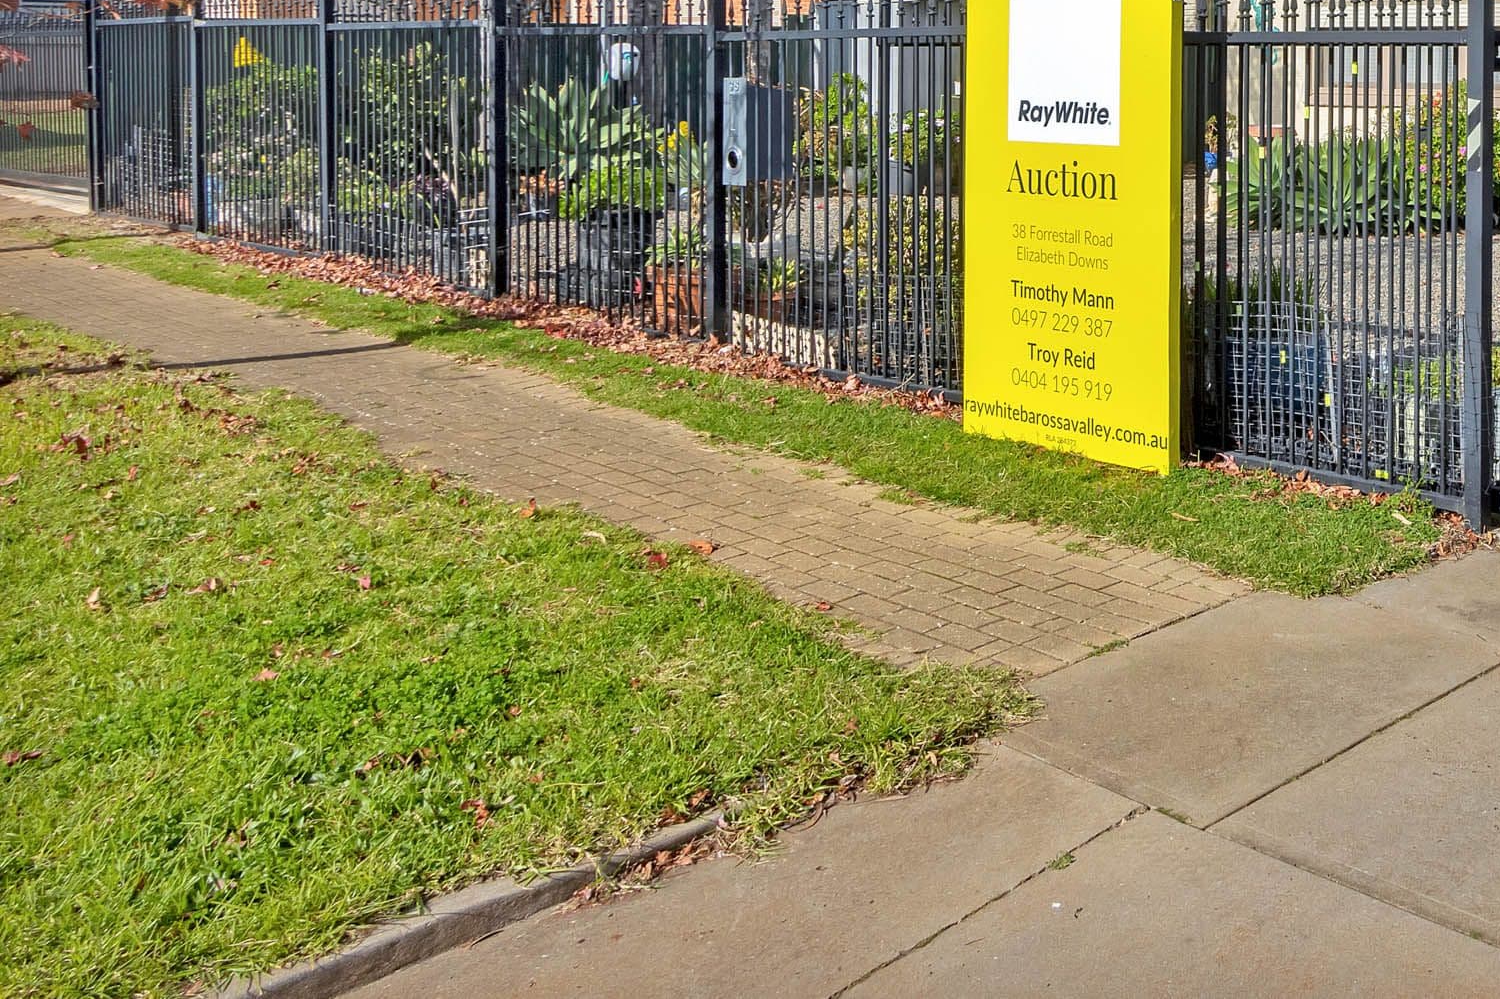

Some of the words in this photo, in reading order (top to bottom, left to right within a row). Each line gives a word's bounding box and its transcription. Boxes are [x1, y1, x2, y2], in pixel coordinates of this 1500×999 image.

[1006, 159, 1118, 200] Auction
[1012, 223, 1027, 239] 38
[1029, 225, 1081, 244] Forrestall
[1084, 230, 1113, 248] Road
[1016, 245, 1065, 265] Elizabeth
[1068, 251, 1109, 270] Downs
[1011, 279, 1068, 308] Timothy
[1072, 287, 1115, 310] Mann
[1011, 307, 1047, 328] 0497
[1052, 312, 1079, 333] 229
[1084, 317, 1113, 338] 387
[1027, 342, 1060, 368] Troy
[1064, 348, 1096, 370] Reid
[1011, 367, 1047, 390] 0404
[1052, 374, 1079, 396] 195
[1084, 379, 1113, 401] 919
[965, 398, 1168, 449] raywhitebarossavalley.com.au
